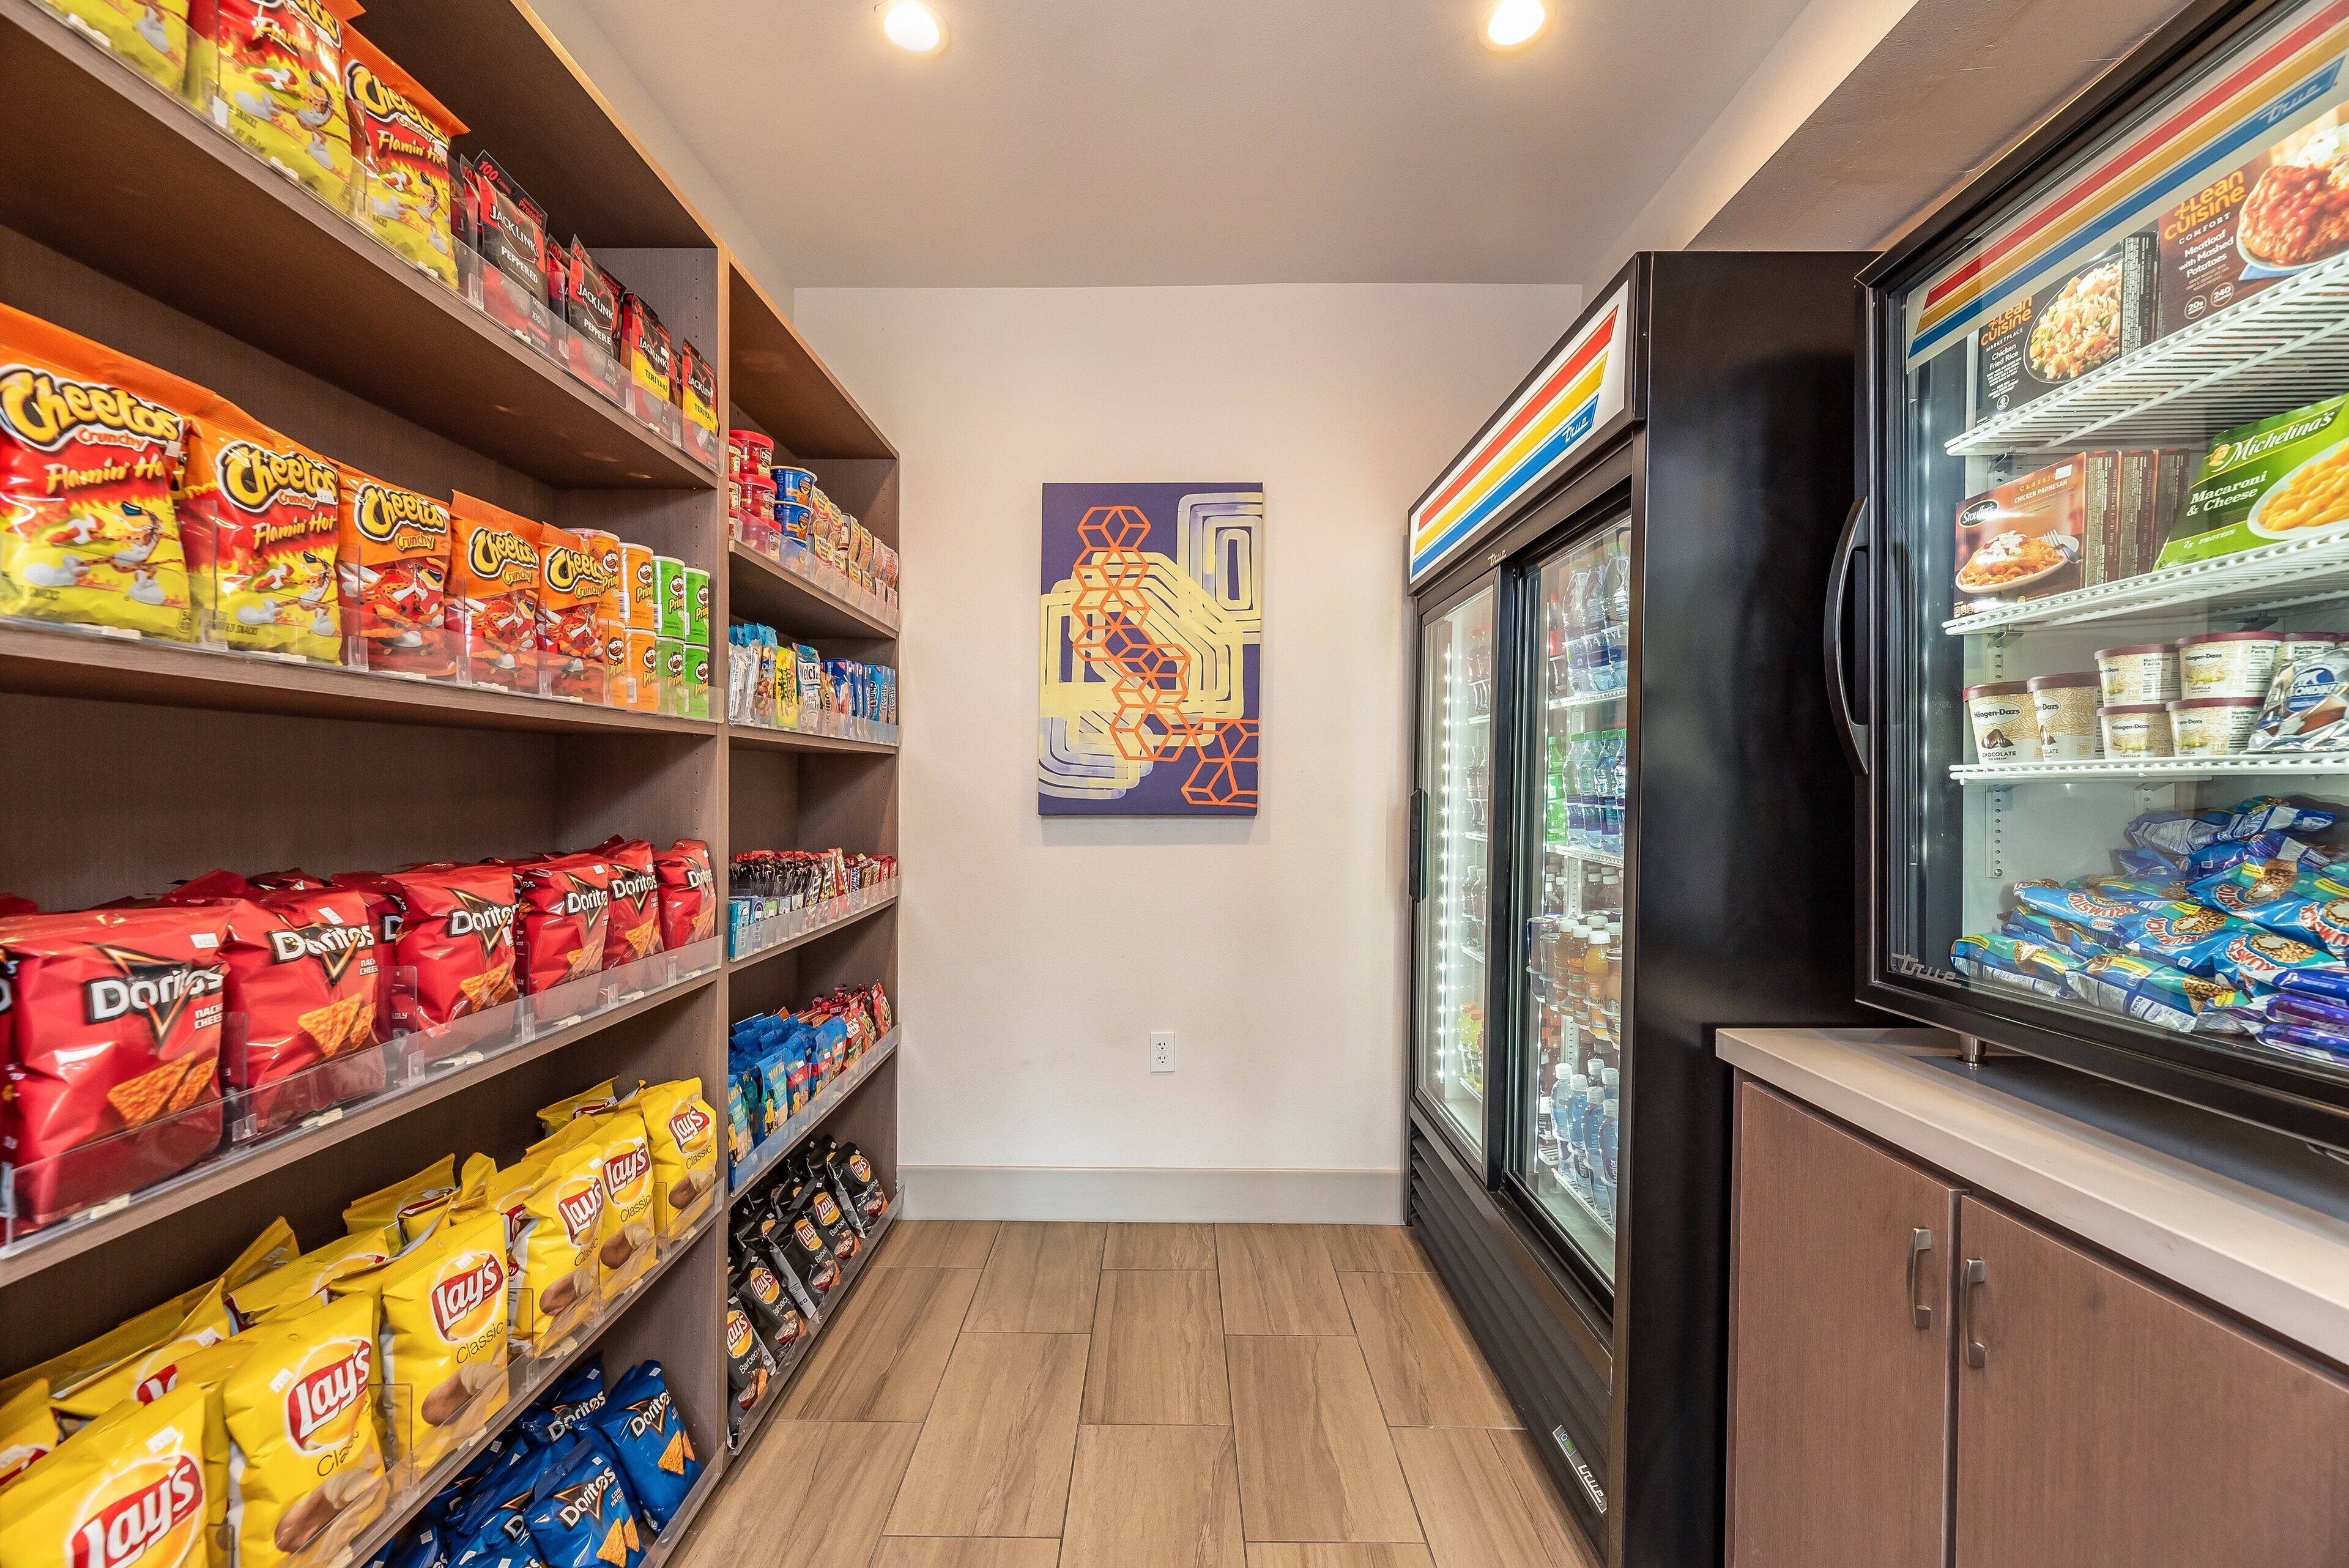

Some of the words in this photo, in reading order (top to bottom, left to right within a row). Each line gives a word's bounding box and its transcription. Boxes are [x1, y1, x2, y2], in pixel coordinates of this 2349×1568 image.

[351, 64, 450, 146] Cheetos
[2258, 84, 2323, 124] true
[377, 129, 424, 156] Flamin'
[479, 161, 499, 180] 100
[2189, 170, 2244, 212] Lean
[489, 204, 516, 237] JACK
[519, 200, 542, 226] Protein
[2178, 212, 2231, 245] COMFORT
[2178, 257, 2196, 272] with
[2197, 236, 2234, 262] Mashed
[2184, 229, 2227, 258] Meatloaf
[501, 245, 538, 284] PEPPERED
[2186, 253, 2227, 278] Potatoes
[577, 282, 597, 308] JACK
[2213, 286, 2232, 300] 240
[1998, 295, 2033, 324] Lean
[584, 317, 612, 346] PEPPERE
[1986, 327, 2024, 353] MARKETPLACE
[1989, 358, 2005, 371] Fried
[2005, 350, 2019, 364] Rice
[1992, 343, 2017, 361] Chicken
[645, 369, 668, 394] TERIYAKI
[0, 371, 180, 443] Cheetos
[76, 428, 146, 449] Crunchy
[1562, 415, 1588, 443] true
[2211, 411, 2336, 473] Michelina's
[43, 456, 131, 495] Flamin'
[225, 446, 337, 506] Cheetos
[2019, 473, 2056, 492] CLASSI
[2190, 470, 2268, 504] Macaroni
[277, 492, 317, 510] Crunchy
[2014, 491, 2037, 504] CHICKEN
[2038, 478, 2068, 495] PARMESAN
[2186, 505, 2200, 517] &
[2203, 487, 2258, 511] Cheese
[361, 486, 445, 537] Cheetos
[1962, 503, 1994, 525] Stouffer's
[251, 516, 307, 550] Flamin'
[308, 511, 336, 533] Hot
[395, 533, 434, 550] Crunchy
[2198, 529, 2236, 545] PROTEIN
[473, 529, 536, 574] Cheetos
[1488, 549, 1507, 567] true
[502, 570, 532, 585] Crunchy
[549, 548, 603, 589] Cheeto
[575, 585, 602, 599] Crunchy
[602, 574, 618, 592] Prin
[636, 585, 653, 603] Prin
[669, 597, 685, 613] Prin
[696, 604, 709, 622] Prin
[643, 671, 656, 688] Prin
[695, 682, 709, 698] Prin
[612, 874, 657, 899] Doritos
[688, 869, 713, 888] Doritos
[567, 890, 608, 914] Dorito
[272, 924, 375, 960] Doritos
[1890, 952, 1962, 989] true
[91, 965, 223, 1020] Doritos
[194, 1013, 223, 1030] CHEES
[195, 1003, 223, 1019] NACH
[671, 1109, 703, 1146] Lay's
[604, 1145, 650, 1195] Lay's
[686, 1144, 713, 1170] Classic
[853, 1157, 867, 1179] Lay's
[561, 1181, 603, 1236] Lay's
[620, 1193, 651, 1223] Classic
[829, 1218, 846, 1237] Barbec
[815, 1247, 828, 1264] Barbec
[435, 1259, 496, 1331] Lay's
[737, 1271, 755, 1298] Lay's
[773, 1296, 789, 1317] Barbec
[456, 1320, 505, 1364] Classic
[296, 1347, 370, 1440] Lay's
[548, 1391, 606, 1441] Doritos
[1577, 1463, 1605, 1504] true
[560, 1467, 616, 1528] Doritos
[610, 1493, 624, 1508] RANC
[73, 1462, 195, 1568] Lay's
